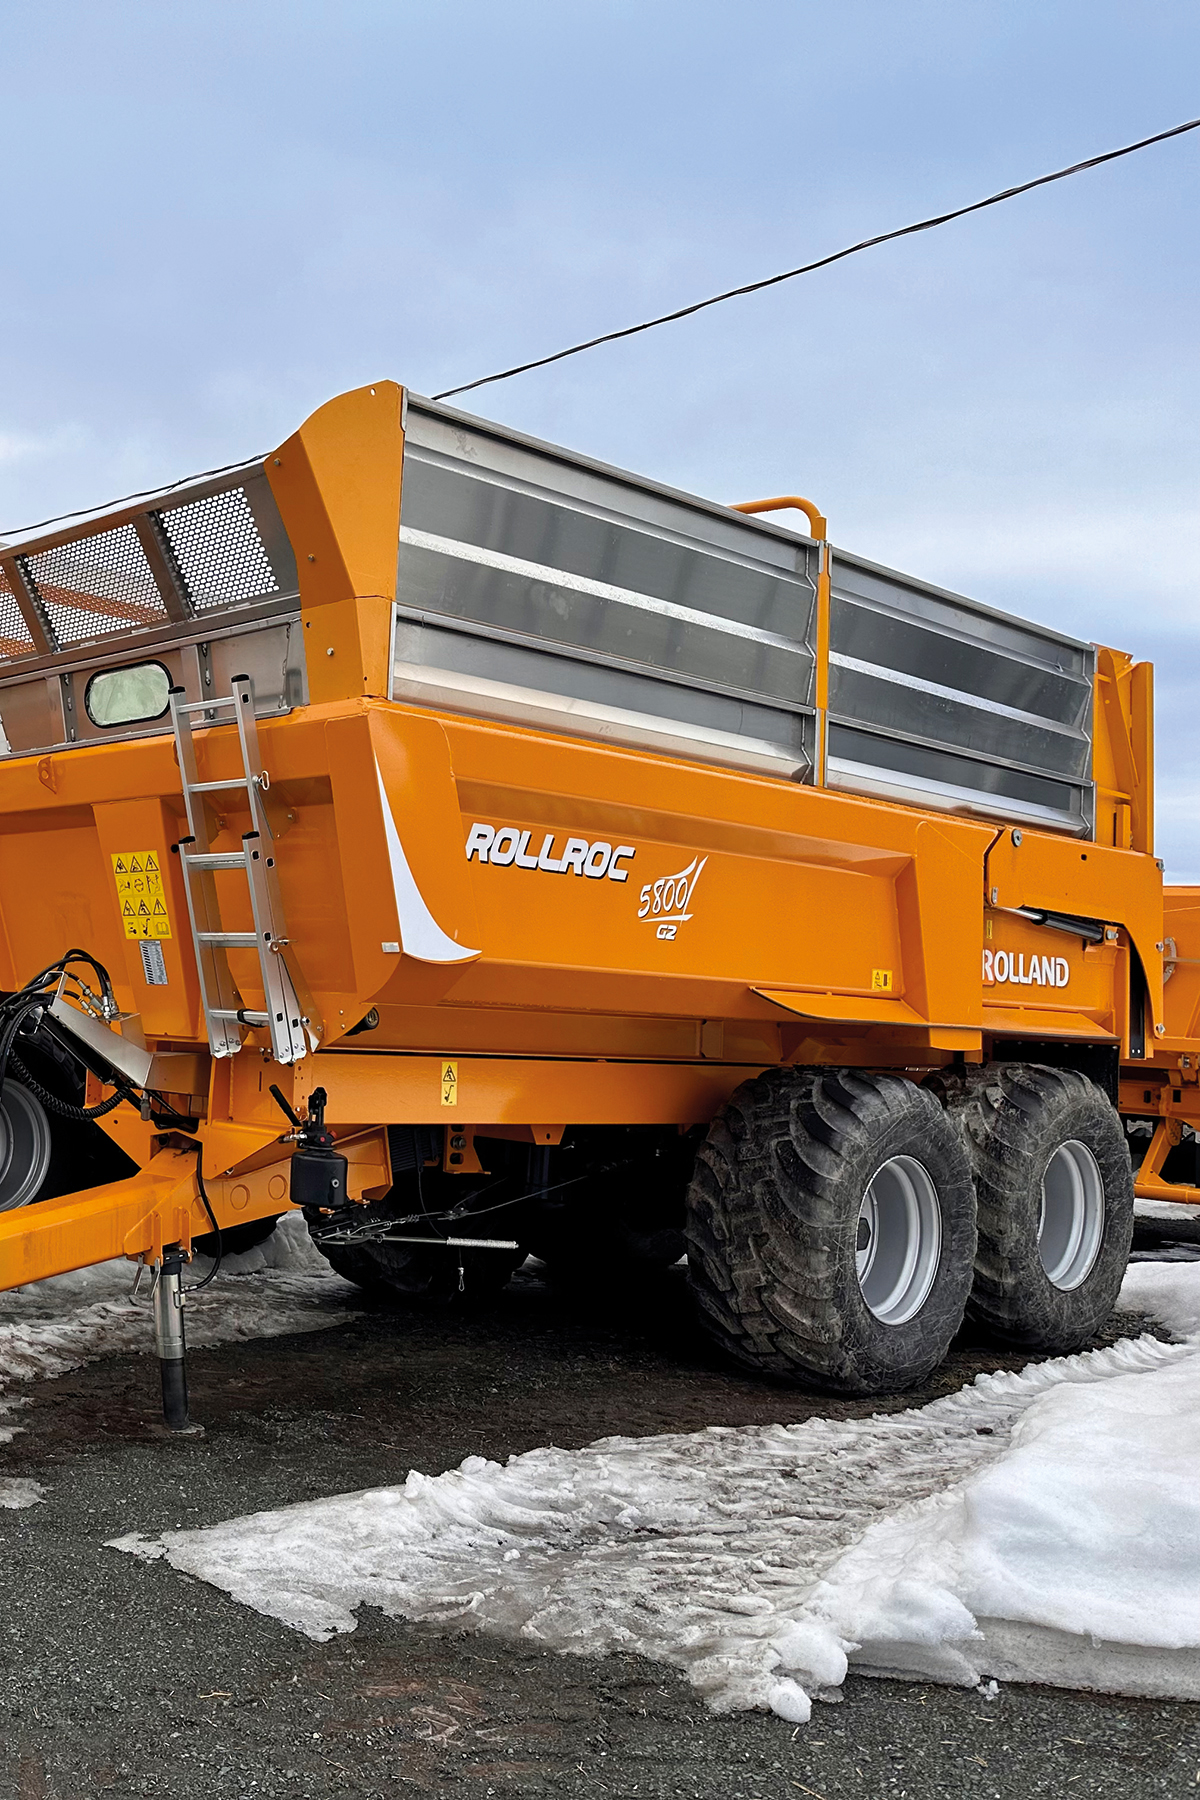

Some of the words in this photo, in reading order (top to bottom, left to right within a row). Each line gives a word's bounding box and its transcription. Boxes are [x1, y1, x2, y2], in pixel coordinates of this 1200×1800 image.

[465, 822, 635, 882] ROLLROC
[638, 877, 689, 918] 5800
[656, 924, 678, 941] G2
[982, 949, 1069, 987] ROLLAND
